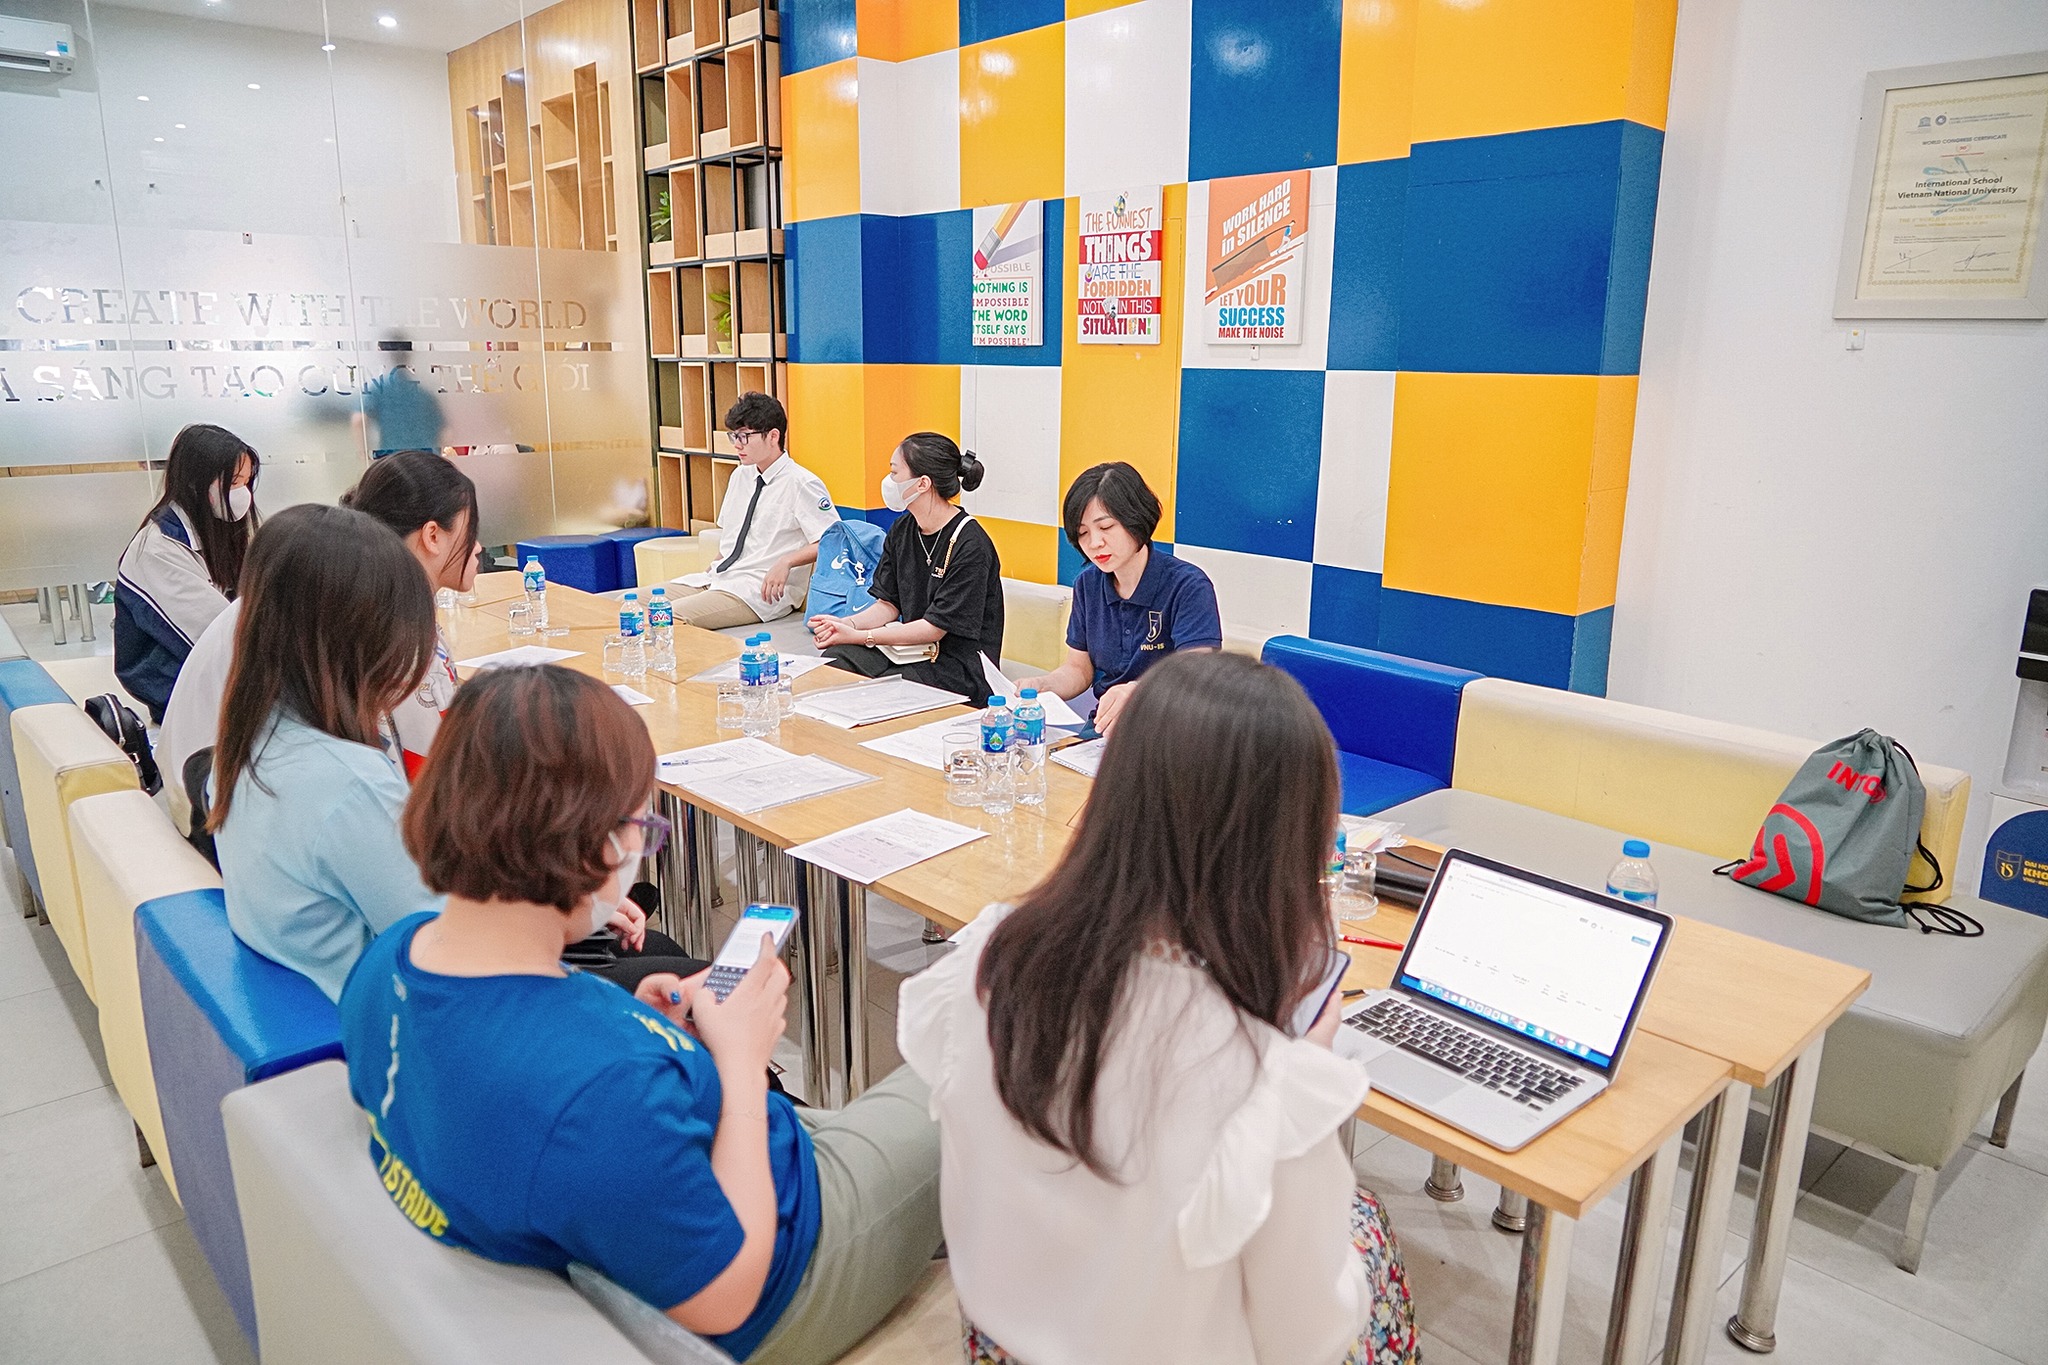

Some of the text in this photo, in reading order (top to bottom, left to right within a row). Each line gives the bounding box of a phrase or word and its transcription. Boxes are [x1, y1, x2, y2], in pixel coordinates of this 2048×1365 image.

[1915, 176, 2003, 188] International School
[1897, 185, 2018, 199] Vietnam National University
[1222, 178, 1291, 237] WORK HARD
[1085, 211, 1103, 233] THE
[1221, 196, 1291, 257] in SILENCE
[1084, 231, 1152, 264] THINGS
[1093, 264, 1116, 280] ARE
[972, 281, 1028, 294] NOTHING IS
[1083, 280, 1151, 297] FORBIDDEN
[1220, 273, 1287, 307] LET YOUR
[16, 285, 219, 325] CREATE
[230, 292, 350, 327] WITH
[449, 298, 587, 329] WORLD
[972, 309, 1028, 321] THE WORD
[1082, 299, 1152, 314] NOT IN THIS
[1218, 307, 1284, 327] SUCCESS
[1004, 324, 1027, 335] SAYS
[1218, 327, 1284, 338] MAKE THE NOISE
[33, 360, 178, 401] SÁNG
